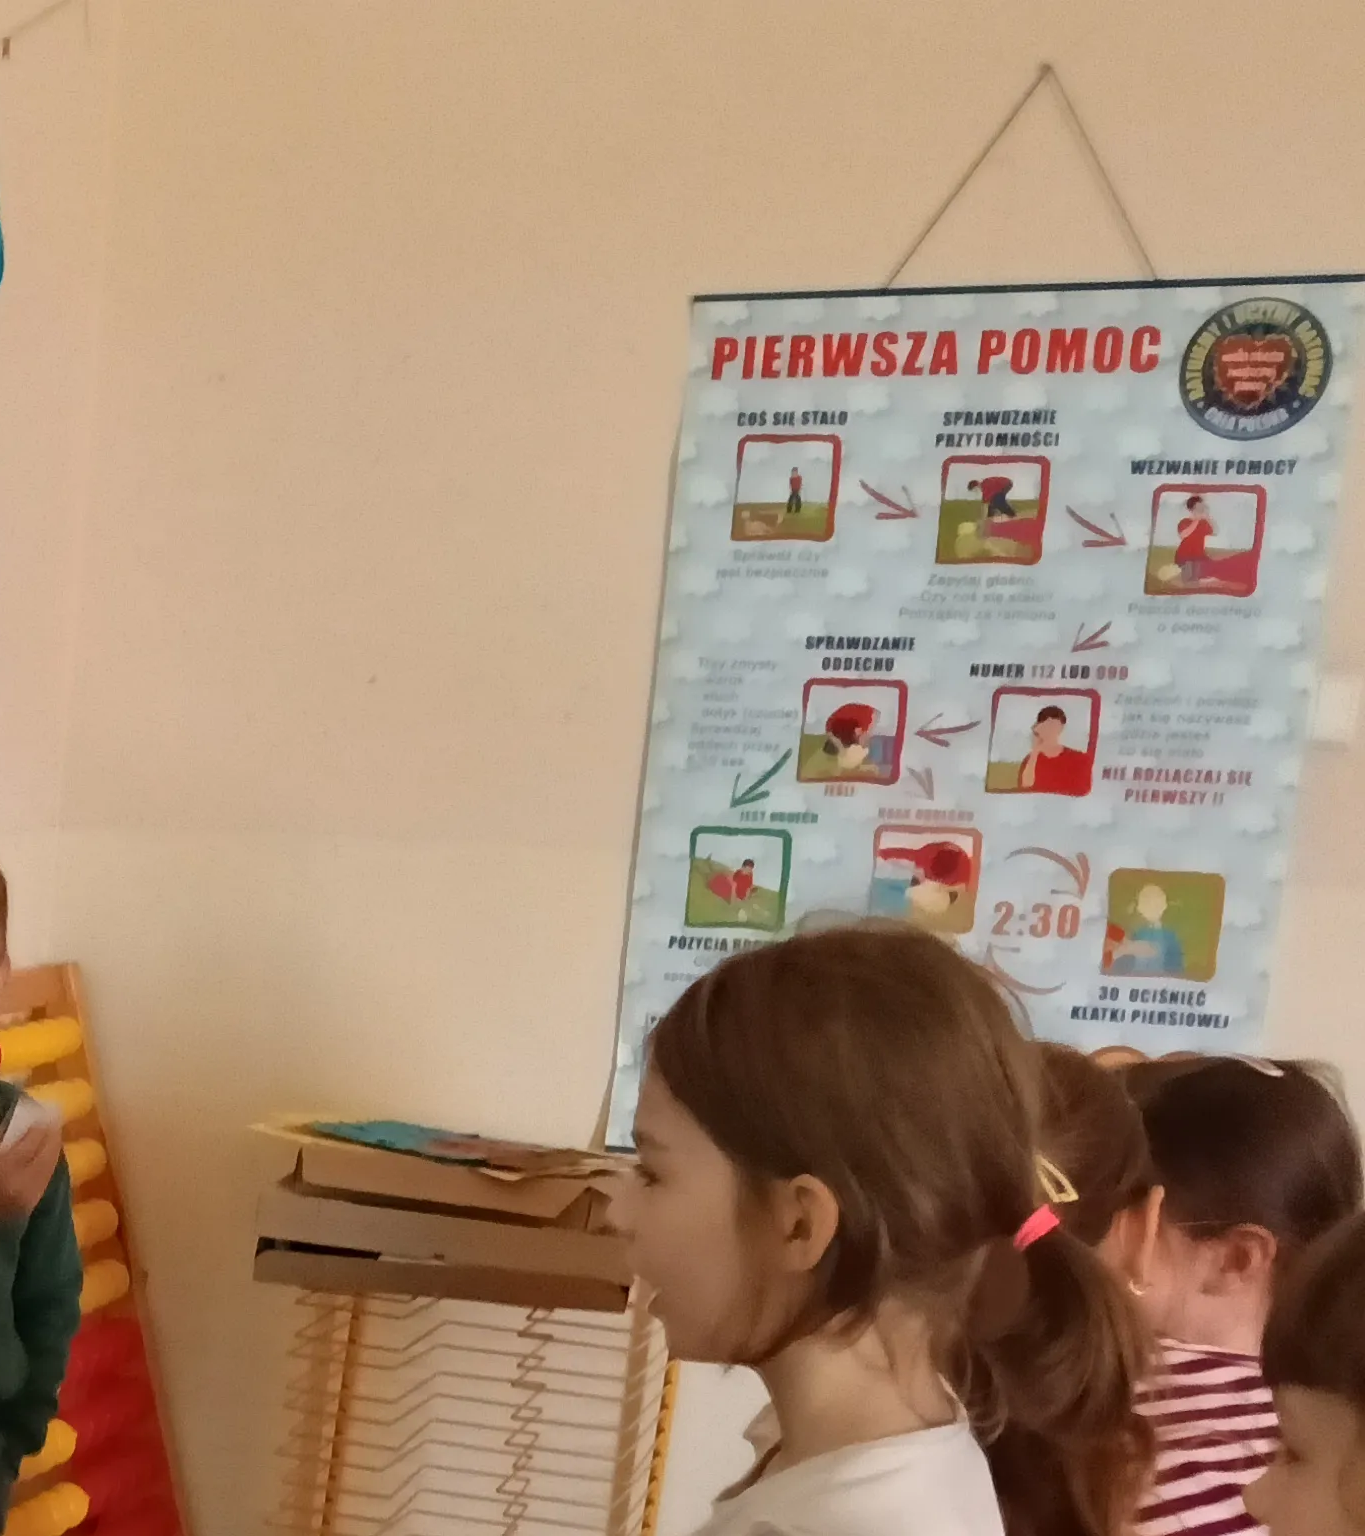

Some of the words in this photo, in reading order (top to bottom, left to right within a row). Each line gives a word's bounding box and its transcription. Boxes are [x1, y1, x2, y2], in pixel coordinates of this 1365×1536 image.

[712, 331, 958, 380] PIERWSZA
[977, 325, 1161, 375] POMOC
[737, 410, 767, 427] COŚ
[943, 409, 1057, 426] SPRAWDZANIE
[935, 430, 1060, 447] PRZYTOMNOŚCI
[1131, 459, 1219, 475] WEZWANIE
[1225, 457, 1298, 475] POMOCY
[805, 635, 916, 651] SPRAWDZANIE
[821, 656, 895, 672] ODDECHU
[970, 663, 1025, 679] NUMER
[1102, 765, 1127, 781] NIE
[1124, 788, 1208, 805] PIERWSZY
[991, 900, 1081, 940] 2:30
[668, 934, 728, 951] POZYCJA
[1098, 985, 1120, 1001] 30
[1129, 987, 1207, 1007] UCIŚNIĘĆ
[1070, 1005, 1126, 1022] KLATKI
[1130, 1008, 1230, 1029] PIERSIOWEJ
